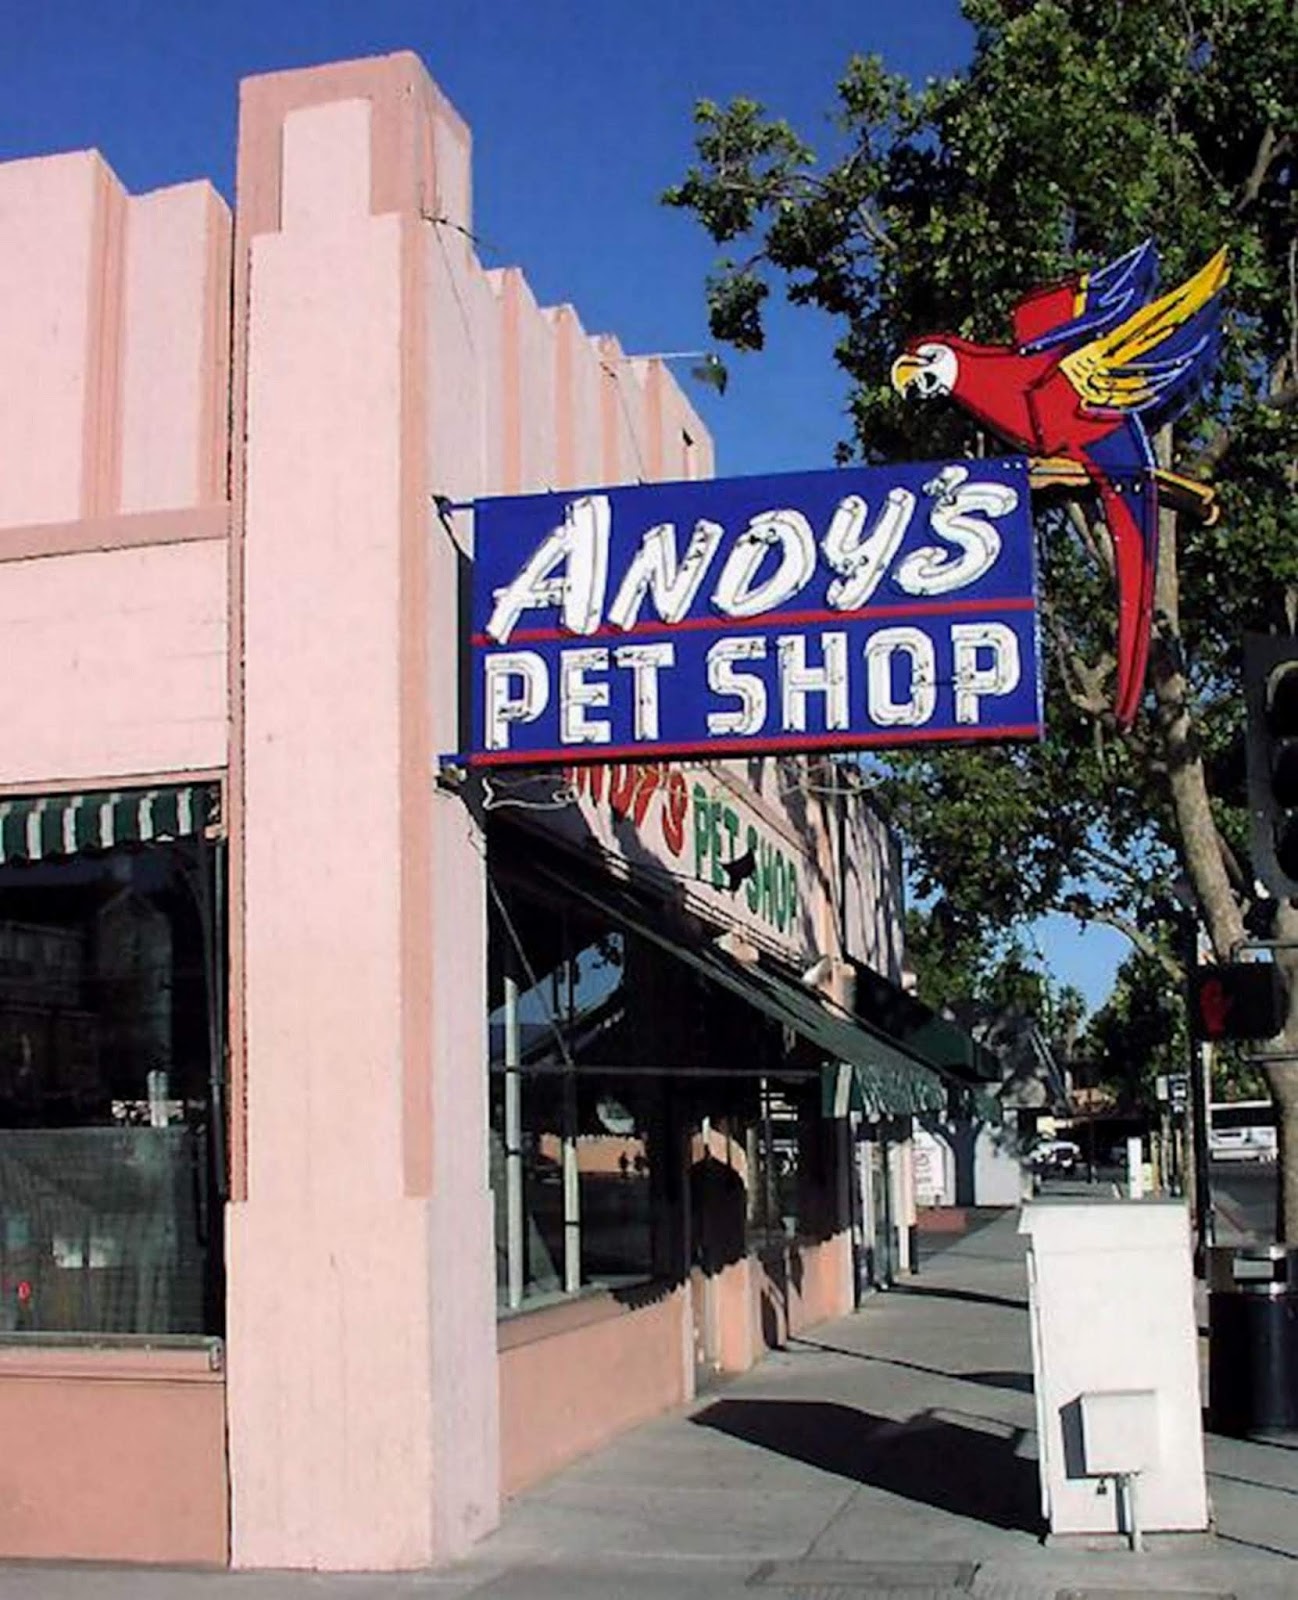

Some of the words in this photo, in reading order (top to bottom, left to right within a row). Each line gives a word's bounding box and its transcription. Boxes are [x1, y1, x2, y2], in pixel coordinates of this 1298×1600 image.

[484, 464, 1019, 644] ANDY'S
[484, 641, 675, 750] PET
[706, 621, 1021, 737] SHOP
[693, 782, 741, 892] PET
[746, 824, 797, 936] SHOP
